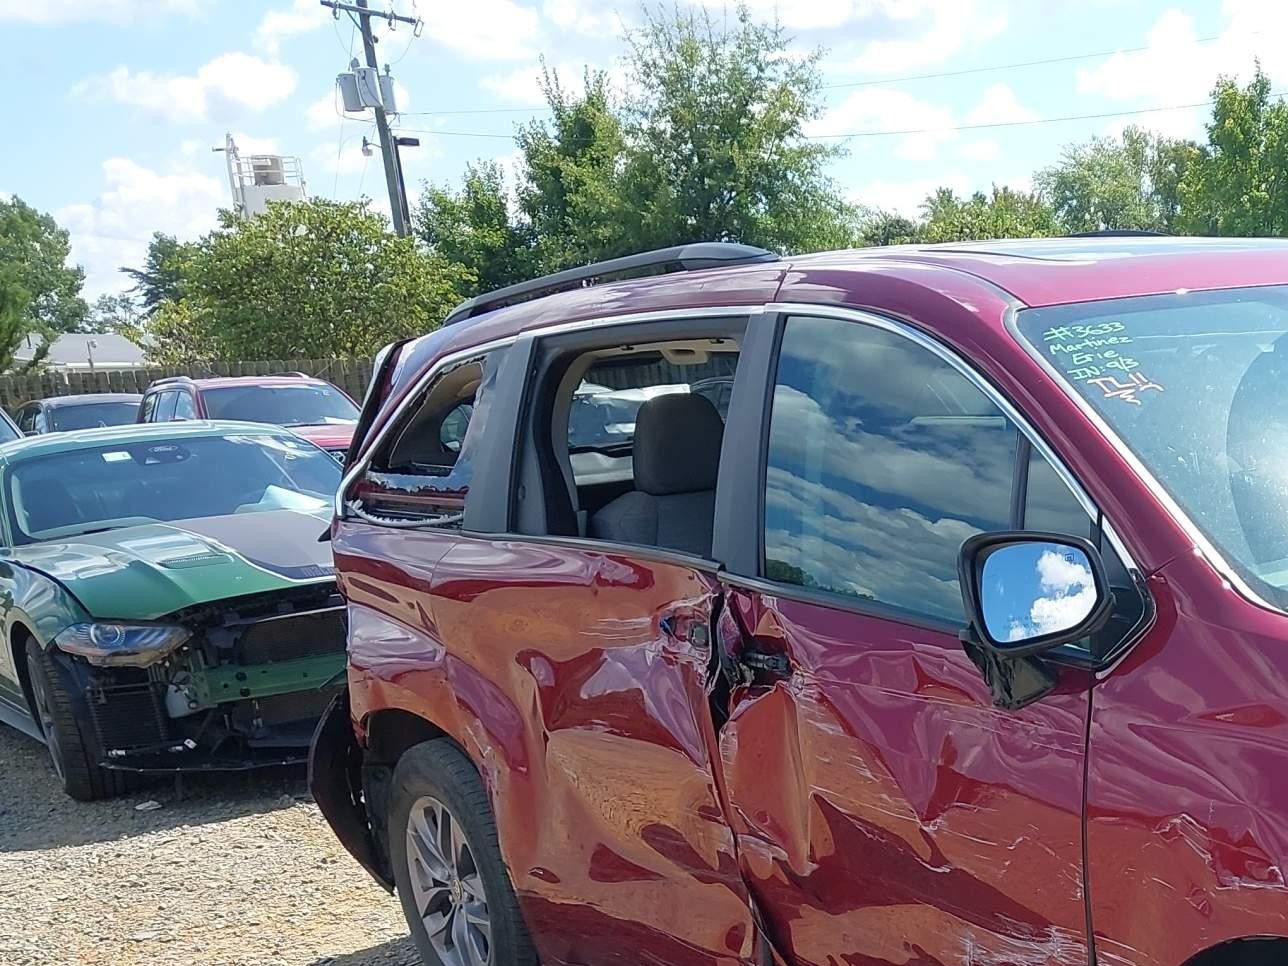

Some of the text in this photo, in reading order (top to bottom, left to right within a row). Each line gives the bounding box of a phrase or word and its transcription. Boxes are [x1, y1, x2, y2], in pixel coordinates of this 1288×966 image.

[1043, 322, 1125, 341] #3633
[1049, 336, 1134, 355] Martinez
[1066, 357, 1140, 380] IN: 9/3
